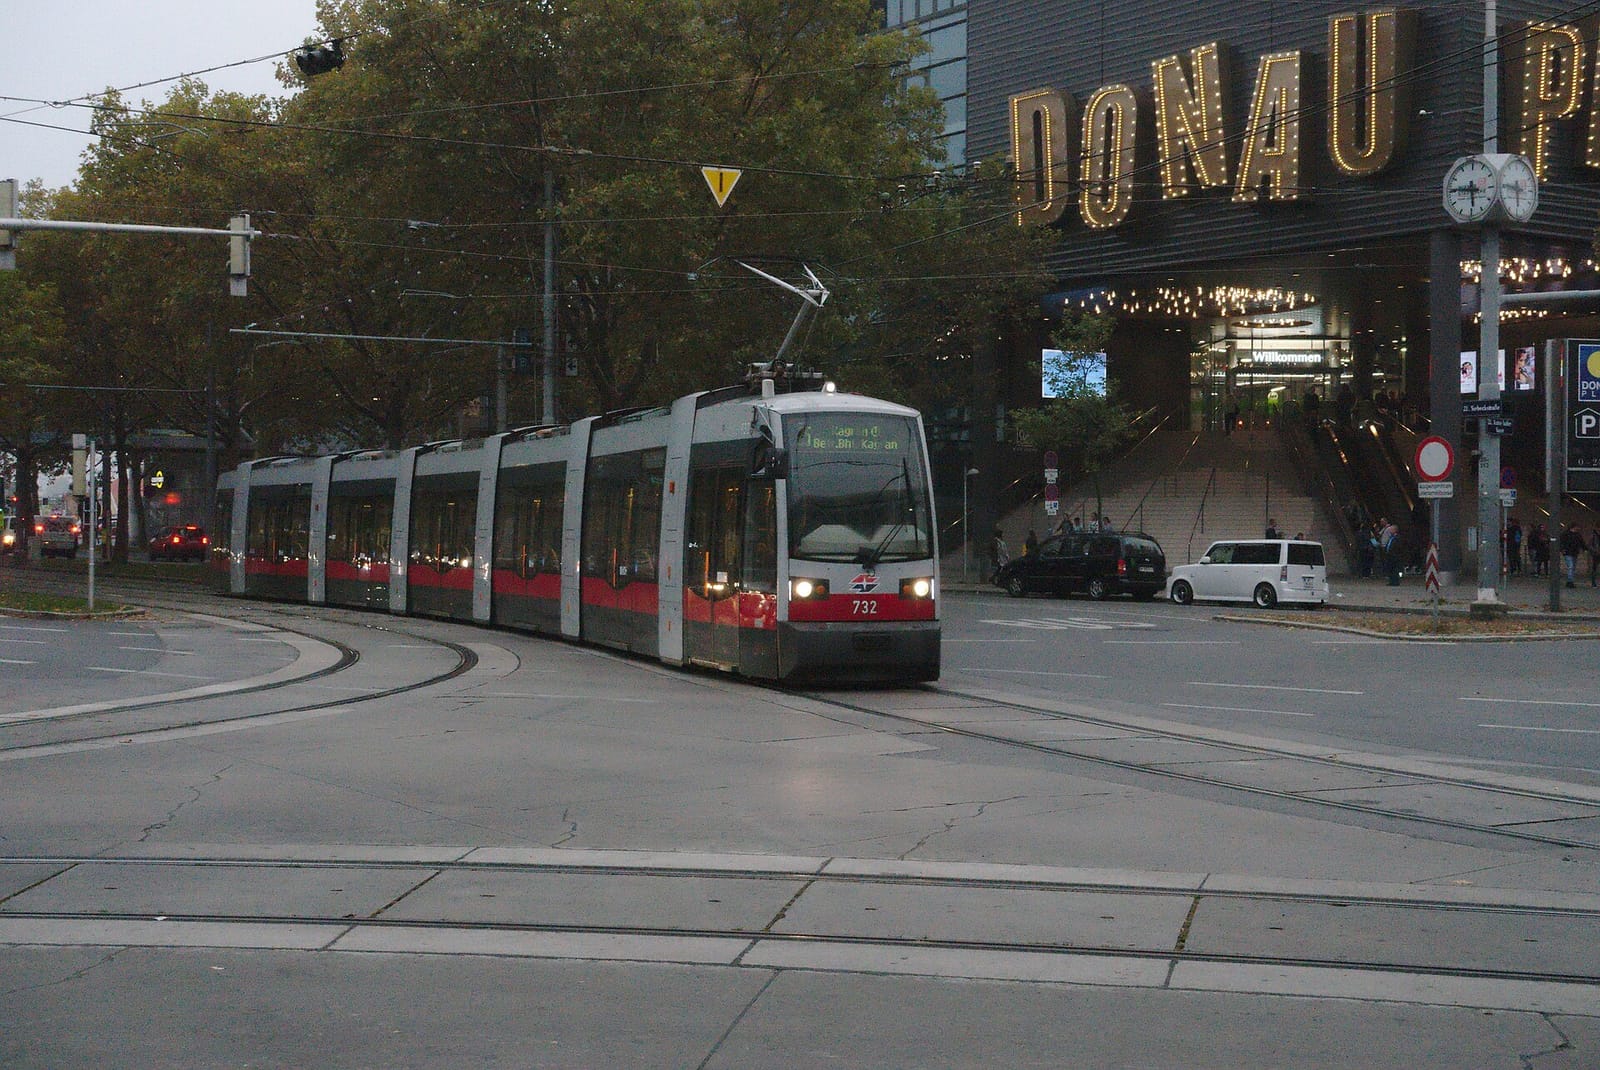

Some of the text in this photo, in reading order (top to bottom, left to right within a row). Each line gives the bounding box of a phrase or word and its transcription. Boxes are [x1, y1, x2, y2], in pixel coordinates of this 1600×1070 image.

[1008, 8, 1600, 229] DONAU P
[1252, 351, 1322, 363] Willkommen
[1581, 415, 1596, 435] P
[861, 439, 898, 450] Kaan
[852, 600, 877, 614] 732
